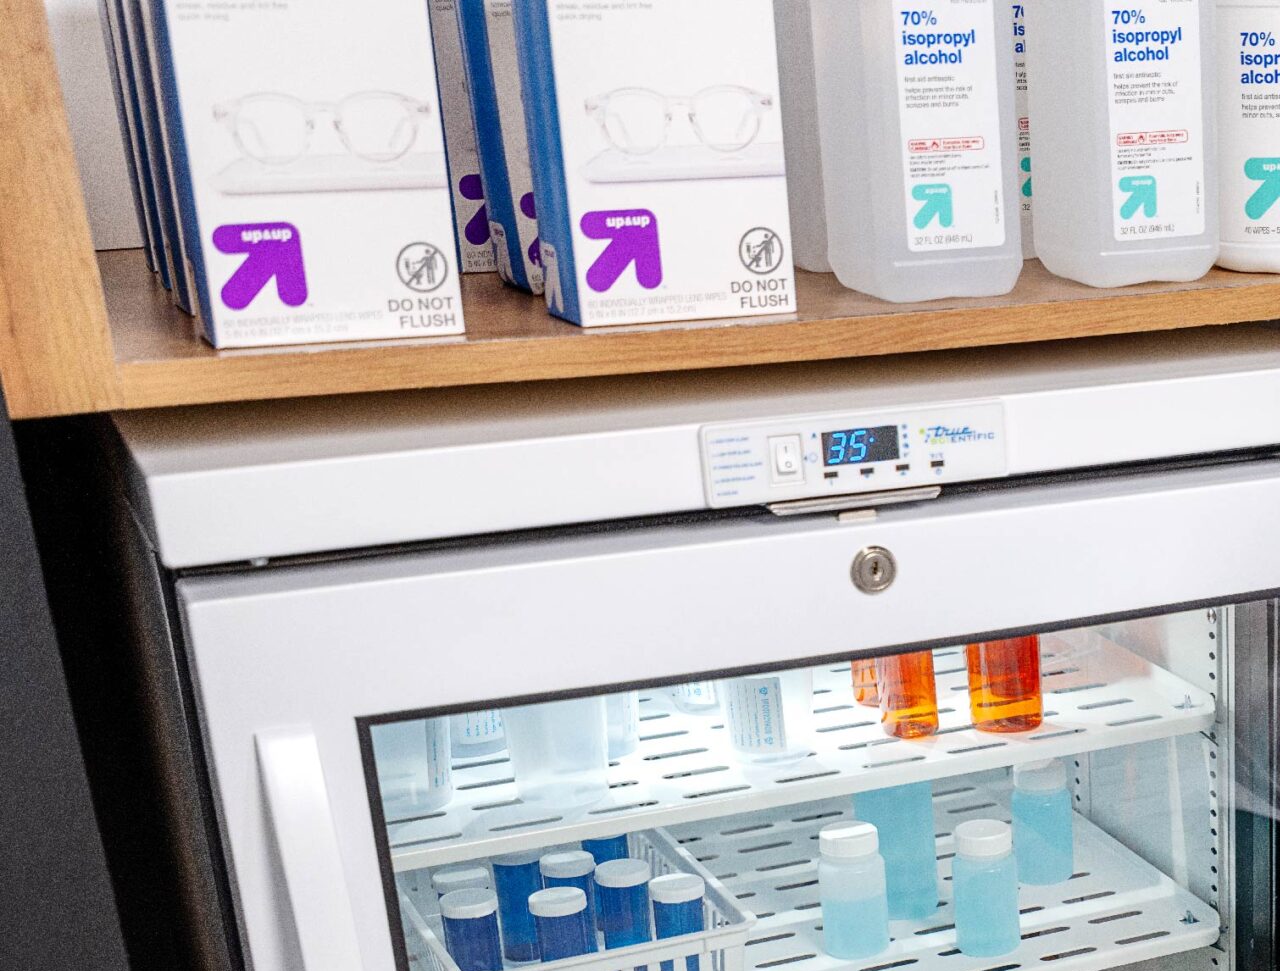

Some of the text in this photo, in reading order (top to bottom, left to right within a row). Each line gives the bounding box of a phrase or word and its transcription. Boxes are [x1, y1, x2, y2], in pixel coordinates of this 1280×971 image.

[901, 10, 938, 26] 70%
[1111, 9, 1146, 25] 70%
[902, 29, 976, 48] isopropyl
[1112, 27, 1182, 45] isopropyl
[1240, 31, 1276, 47] 70%
[904, 49, 962, 65] alcohol
[1114, 46, 1169, 62] alcohol
[730, 279, 788, 295] DO NOT
[387, 297, 454, 313] DO NOT
[740, 294, 789, 309] FLUSH
[400, 314, 457, 330] FLUSH
[927, 426, 972, 438] true
